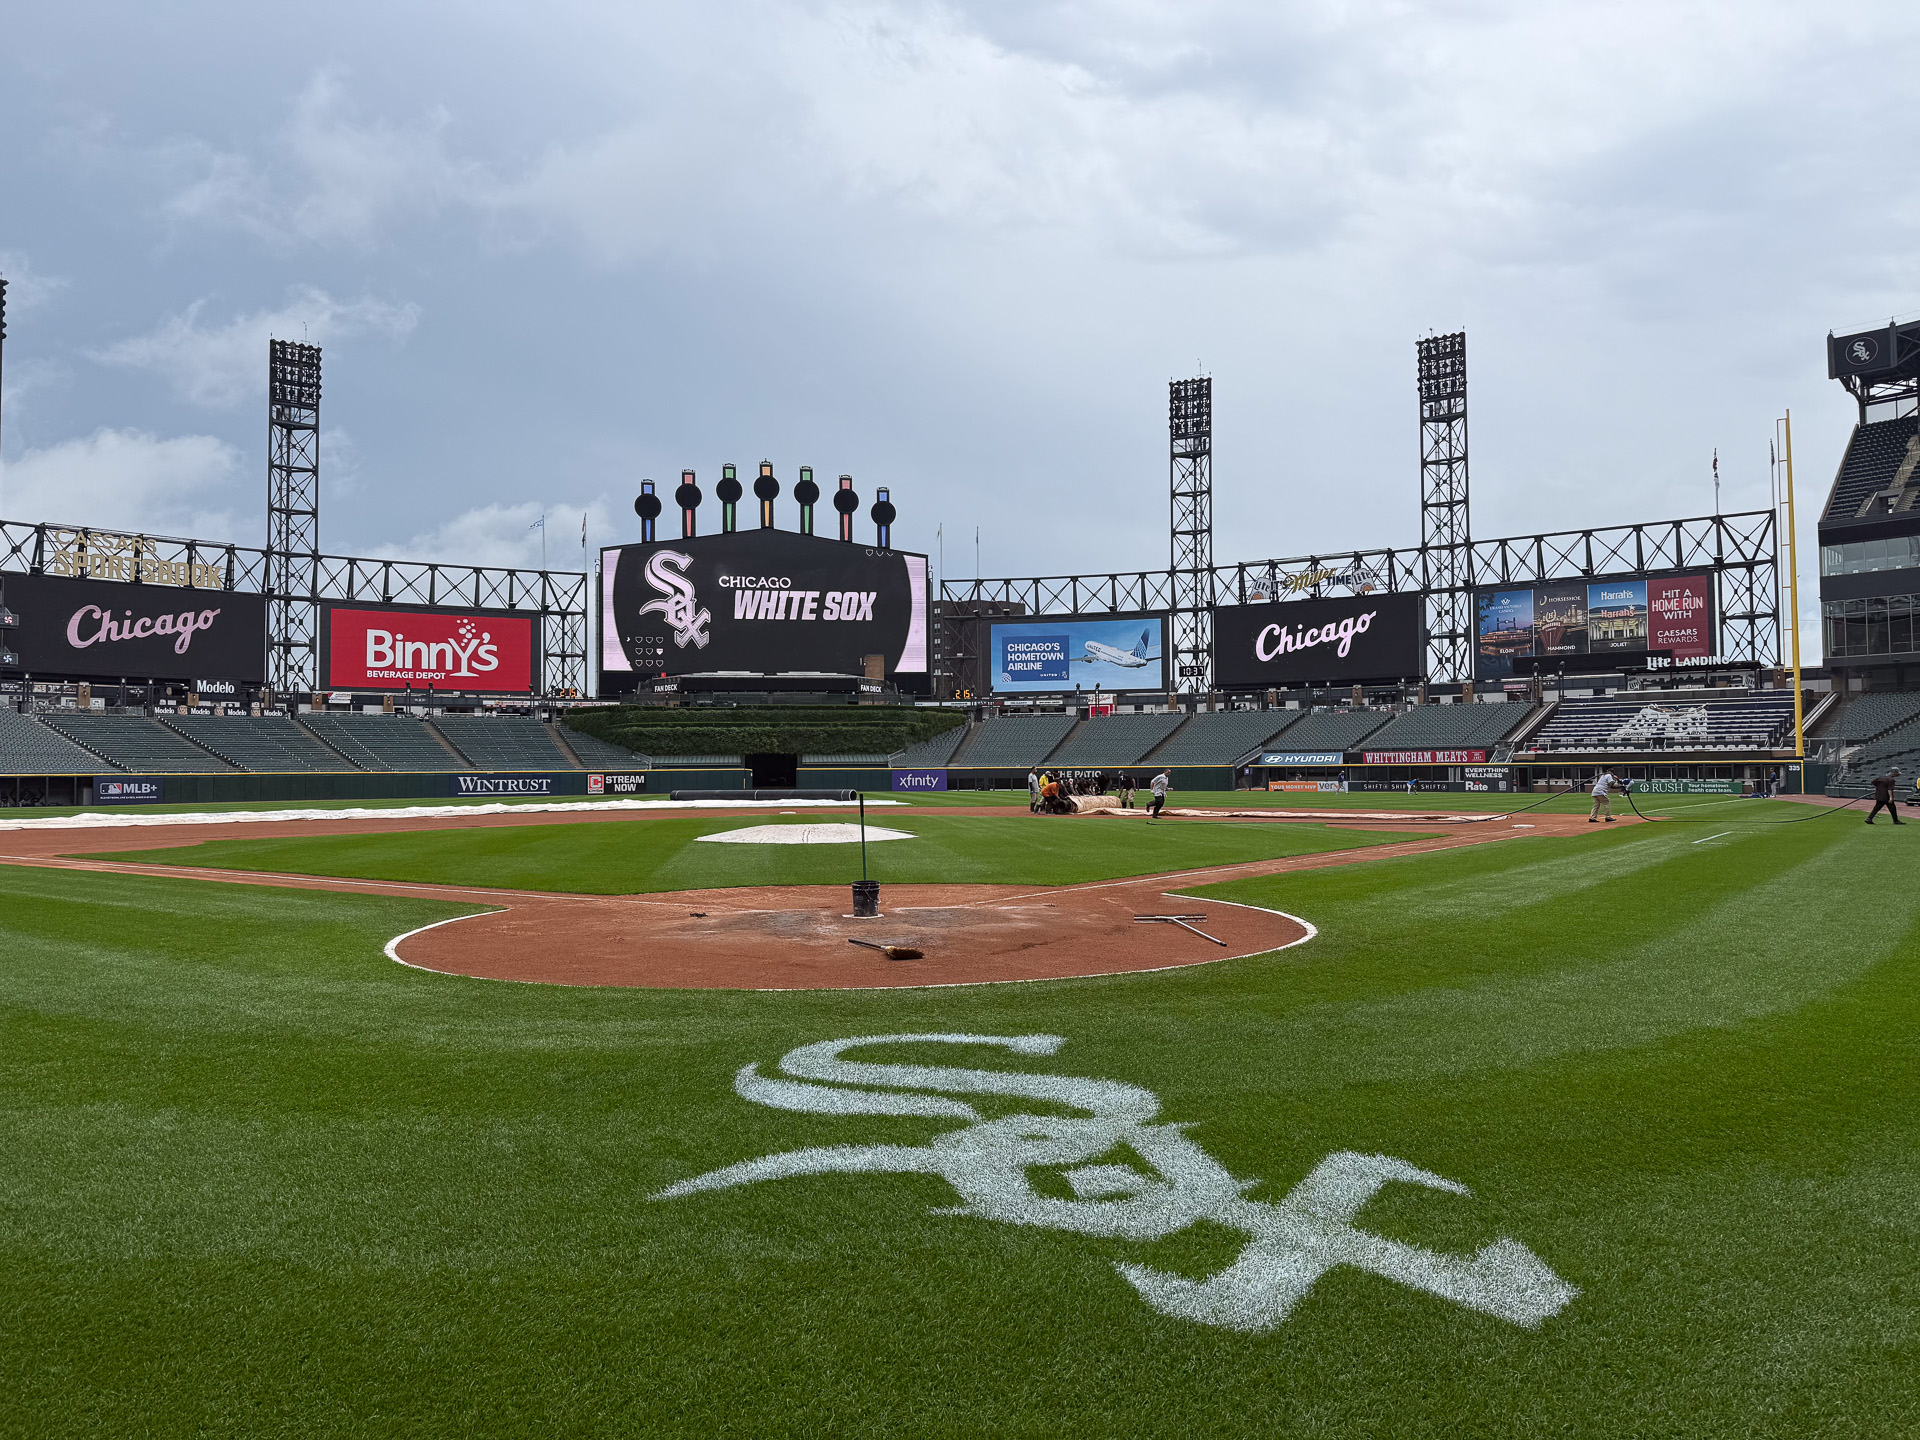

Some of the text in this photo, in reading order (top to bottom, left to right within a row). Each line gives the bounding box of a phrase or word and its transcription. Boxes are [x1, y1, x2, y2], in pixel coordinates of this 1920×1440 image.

[55, 529, 157, 553] CAESARS
[54, 549, 223, 589] SPORTSBOOK
[718, 575, 791, 589] CHICAGO
[1283, 567, 1338, 594] Miller
[1326, 575, 1352, 586] TIME
[1662, 588, 1692, 599] HIT A
[1548, 595, 1581, 603] HORSESHOE
[734, 590, 877, 621] WHITE SOX
[1652, 597, 1703, 612] HOME RUN
[1663, 610, 1692, 620] WITH
[66, 604, 221, 654] Chicago
[1657, 628, 1698, 637] CAESARS
[1256, 611, 1376, 661] Chicago
[1007, 642, 1060, 652] CHICAGO'S
[367, 629, 499, 677] Binny's
[1007, 653, 1064, 661] HOMETOWN
[1007, 662, 1042, 671] AIRLINE
[1646, 655, 1730, 671] Lite LANDING
[366, 670, 446, 680] BEVERAGE DEPOT
[197, 680, 235, 694] Modelo
[654, 683, 678, 692] FAN DECK
[860, 684, 882, 693] FAN DECK
[154, 706, 175, 715] Modelo
[190, 707, 211, 716] Modelo
[227, 708, 247, 716] Modelo
[263, 709, 283, 717] Modelo
[1284, 755, 1337, 763] HYUNDAI
[1365, 751, 1468, 764] WHITTINGHAM MEATS
[1074, 770, 1102, 778] PATIO
[605, 775, 645, 784] STREAM
[899, 774, 939, 788] xfinity
[123, 783, 158, 794] MLB+
[614, 783, 637, 792] NOW
[1465, 780, 1488, 791] Rate
[1652, 782, 1684, 792] RUSH
